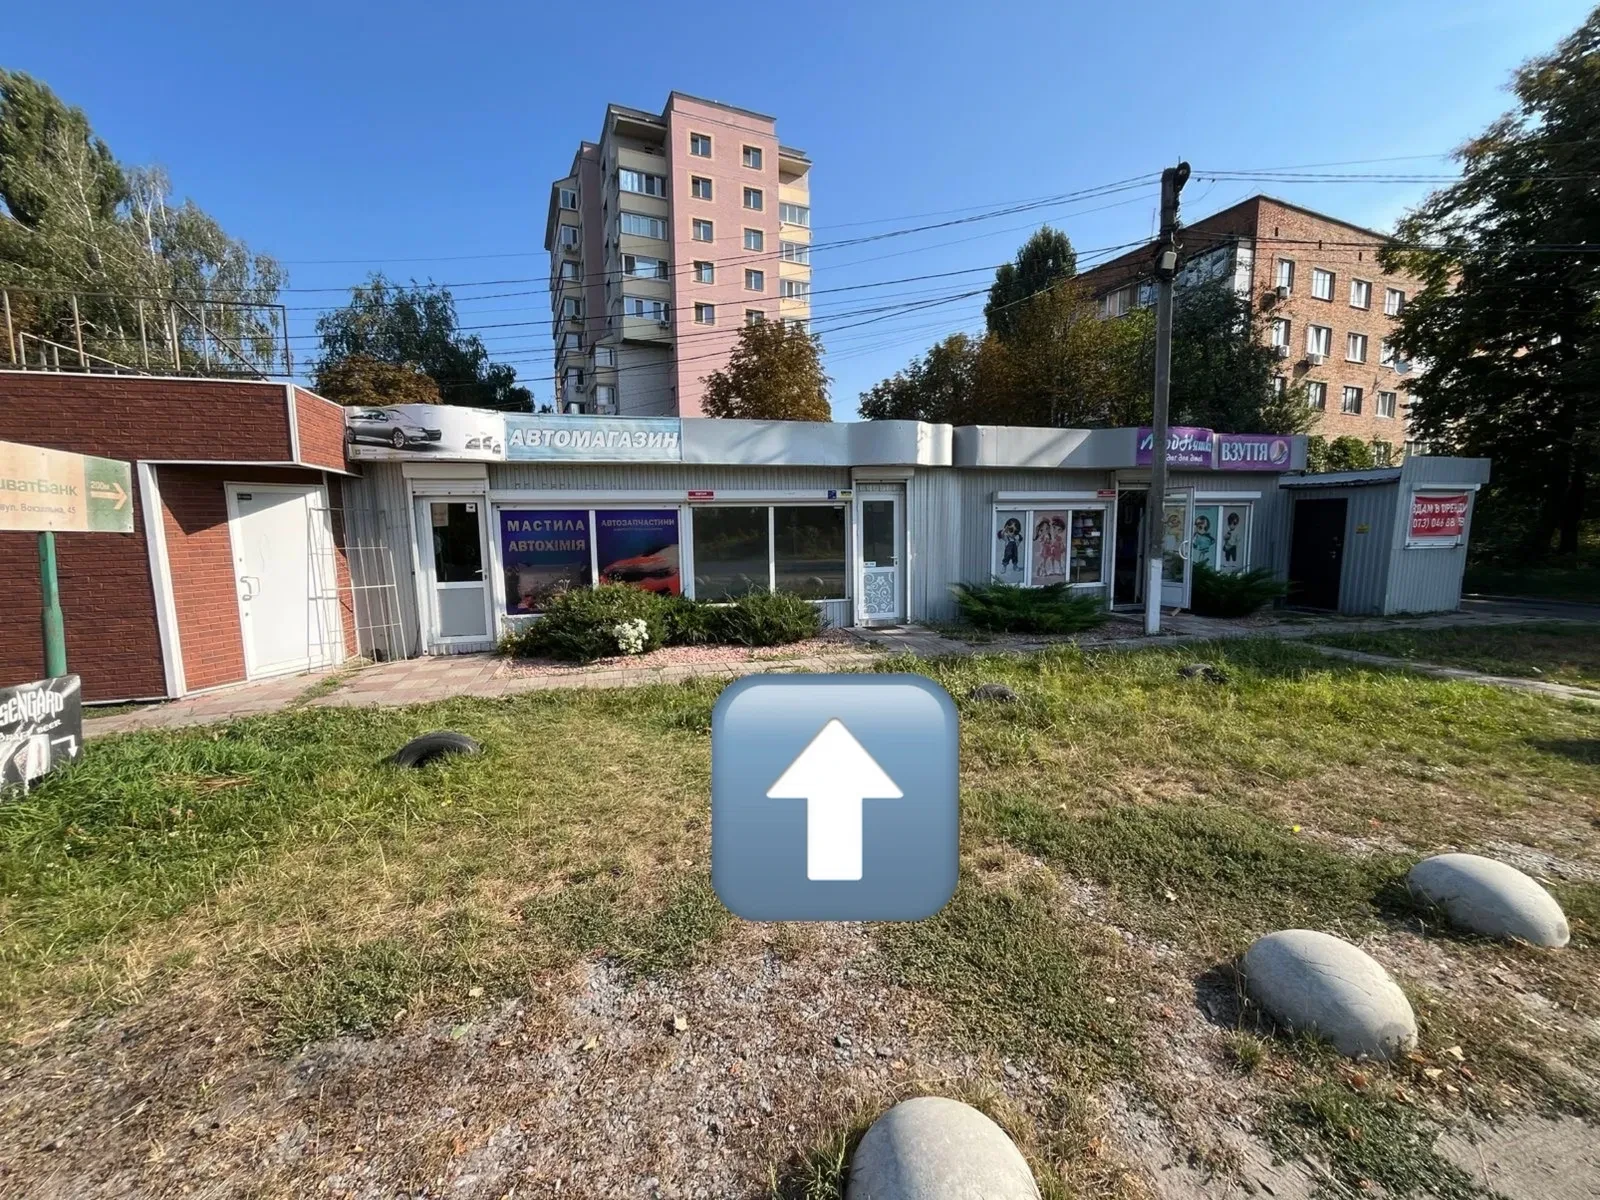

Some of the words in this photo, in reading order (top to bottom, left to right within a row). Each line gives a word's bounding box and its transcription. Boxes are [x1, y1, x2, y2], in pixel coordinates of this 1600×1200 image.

[508, 428, 679, 449] АВТОМАГАЗИН
[1221, 441, 1268, 461] ВЗУТТЯ
[507, 519, 585, 532] МАСТИЛА
[601, 518, 675, 527] АВТОЗАПЧАСТИНИ
[509, 539, 586, 552] АВТОХІМІЯ
